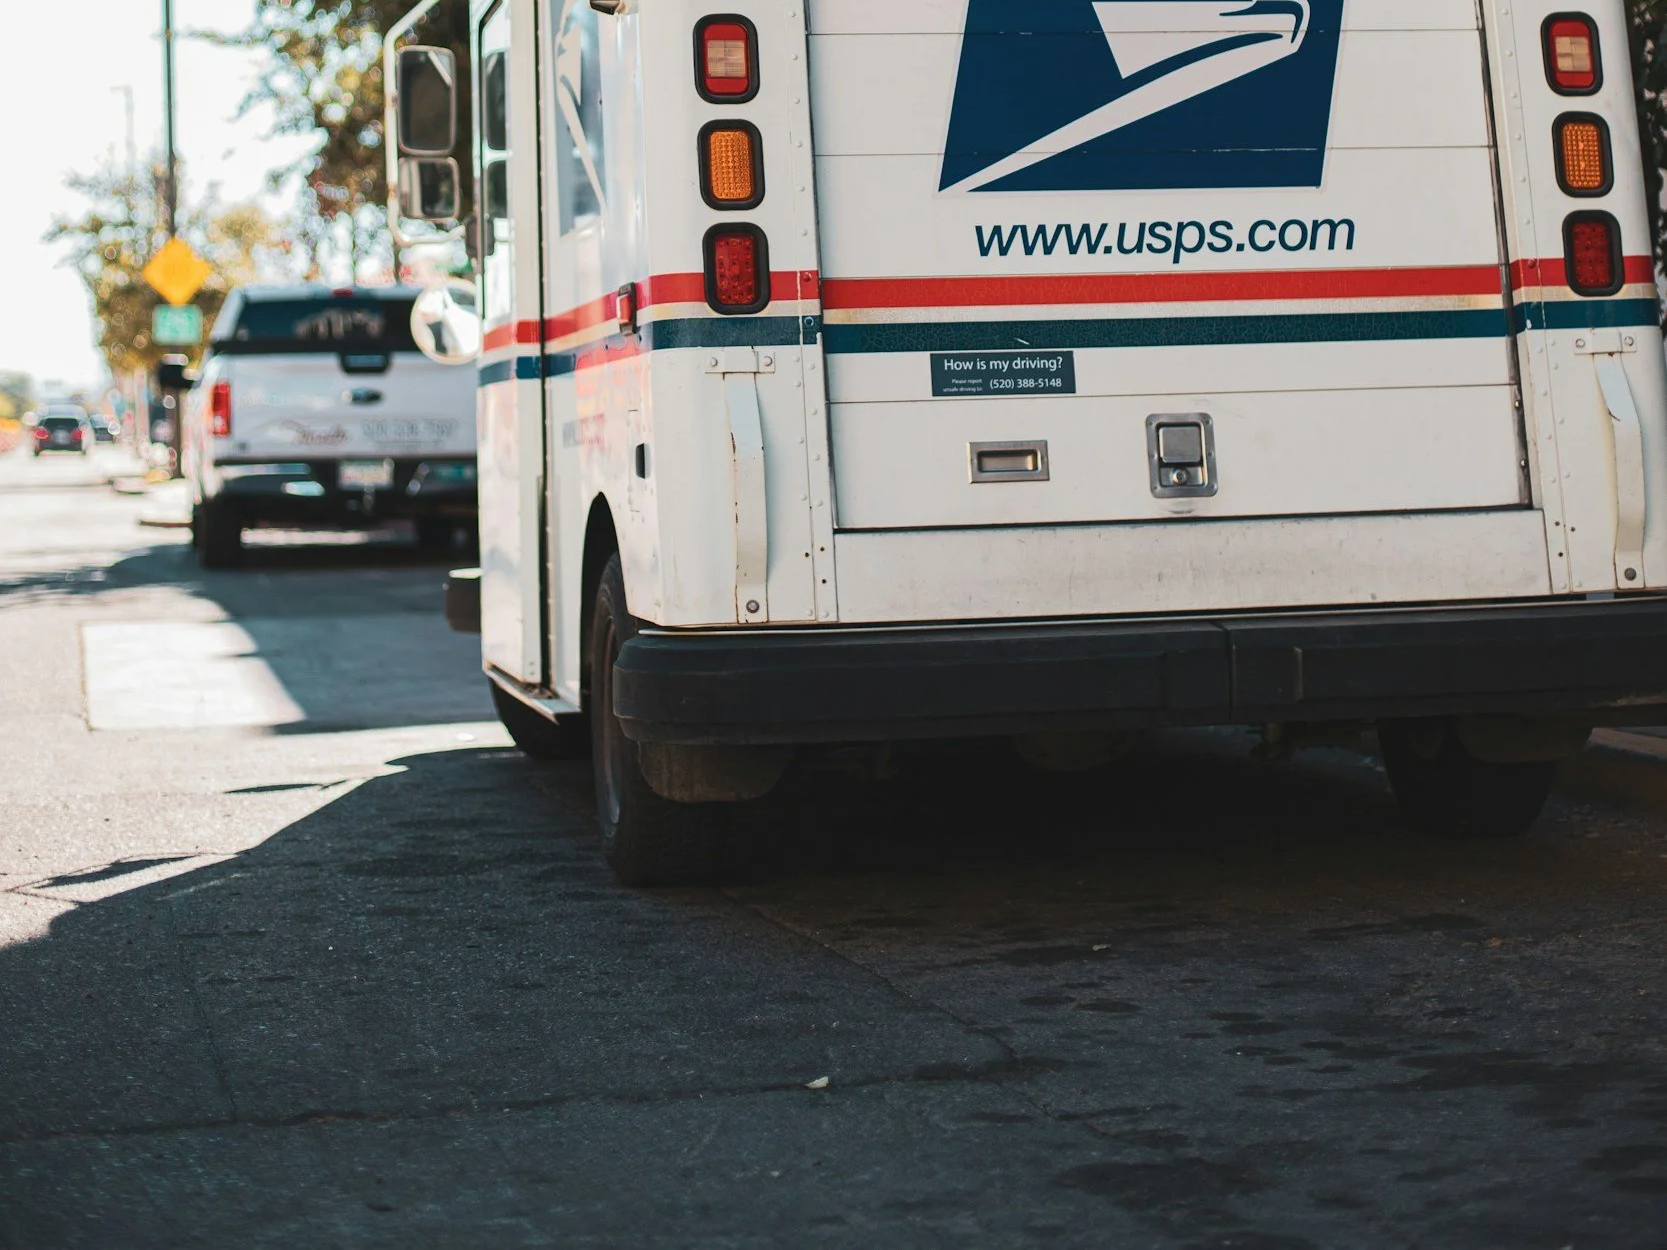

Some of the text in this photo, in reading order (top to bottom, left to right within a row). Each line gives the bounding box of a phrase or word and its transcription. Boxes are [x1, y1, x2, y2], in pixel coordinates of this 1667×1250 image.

[974, 217, 1356, 265] www.usps.com
[943, 356, 1063, 372] How is my driving?
[989, 377, 1062, 390] (520) 388-5148
